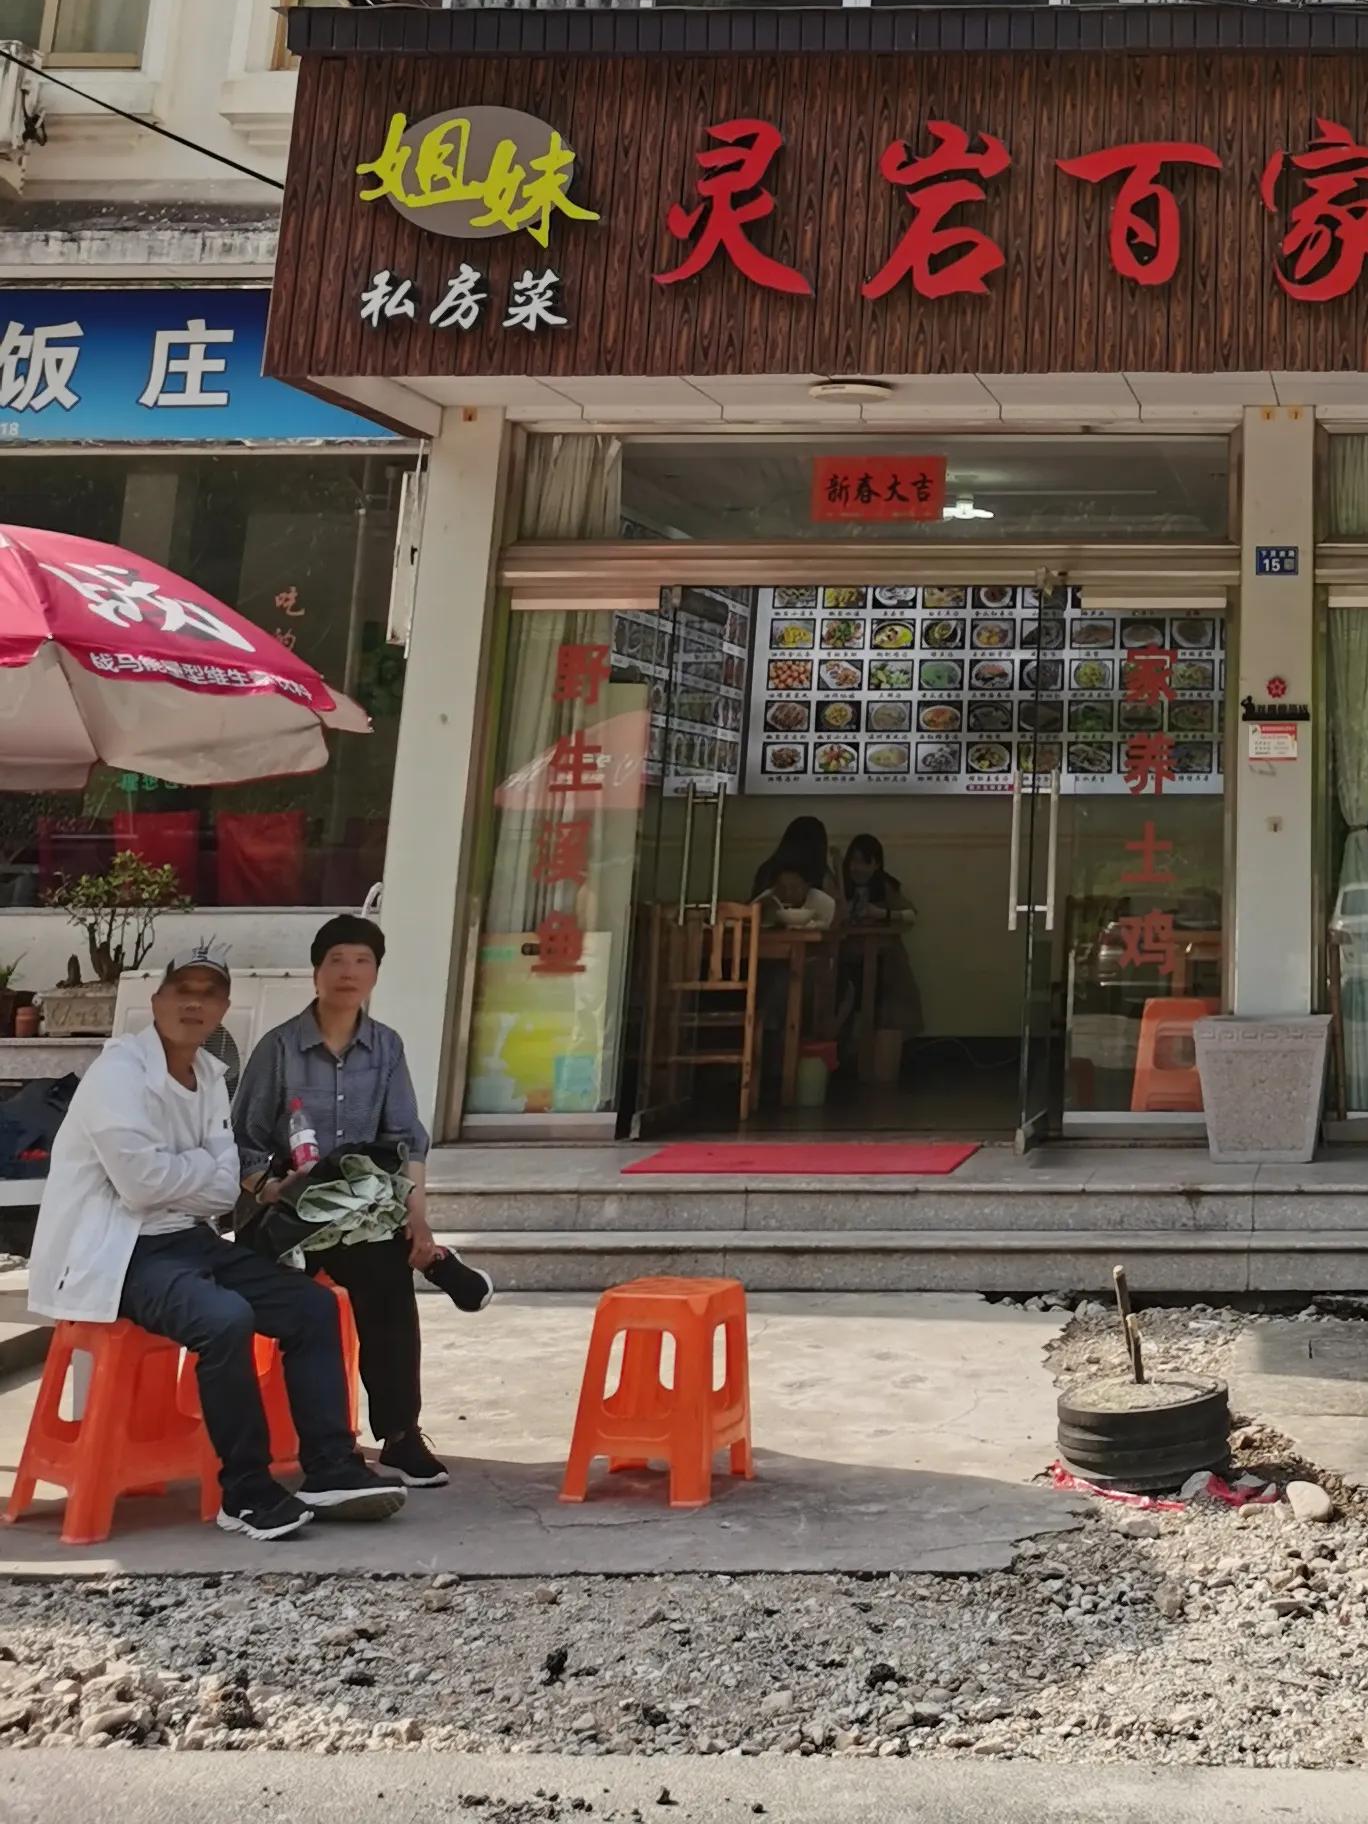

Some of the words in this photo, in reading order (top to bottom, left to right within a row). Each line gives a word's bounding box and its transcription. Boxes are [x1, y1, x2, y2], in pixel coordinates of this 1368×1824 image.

[356, 112, 601, 249] 姐妹
[360, 264, 568, 332] 私房菜
[0, 319, 235, 412] 饭庄
[824, 472, 934, 508] 新春大吉
[1263, 558, 1281, 572] 15
[530, 644, 612, 976] 野生溪鱼
[1117, 644, 1178, 978] 家养土鸡
